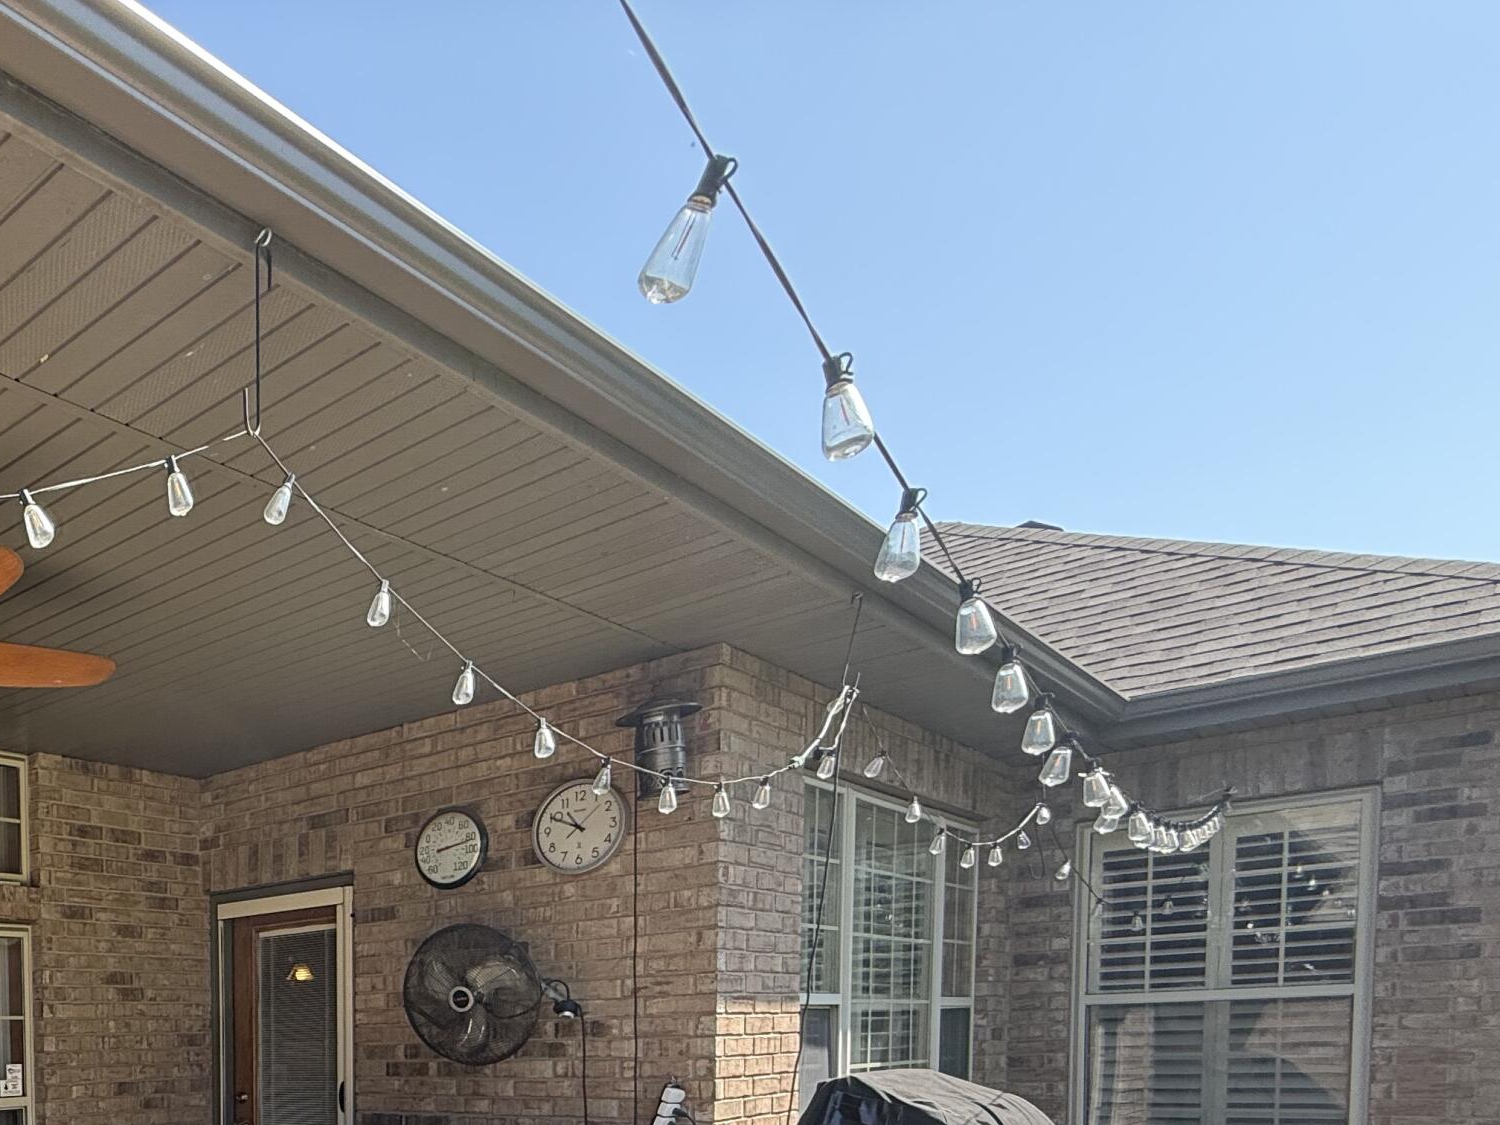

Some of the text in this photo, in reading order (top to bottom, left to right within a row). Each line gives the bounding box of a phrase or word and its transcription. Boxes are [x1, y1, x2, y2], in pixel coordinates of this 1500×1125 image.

[575, 790, 587, 801] 12
[562, 798, 569, 809] 11
[604, 800, 612, 812] 2
[550, 811, 564, 823] 10
[609, 816, 617, 828] 3
[432, 822, 442, 832] 20
[458, 820, 468, 830] 60
[544, 826, 552, 838] 9
[426, 834, 431, 844] 0
[604, 832, 612, 844] 4
[465, 844, 478, 854] 100
[548, 842, 556, 853] 8
[592, 846, 599, 858] 5
[560, 851, 568, 862] 7
[575, 854, 582, 864] 6
[454, 860, 468, 871] 120
